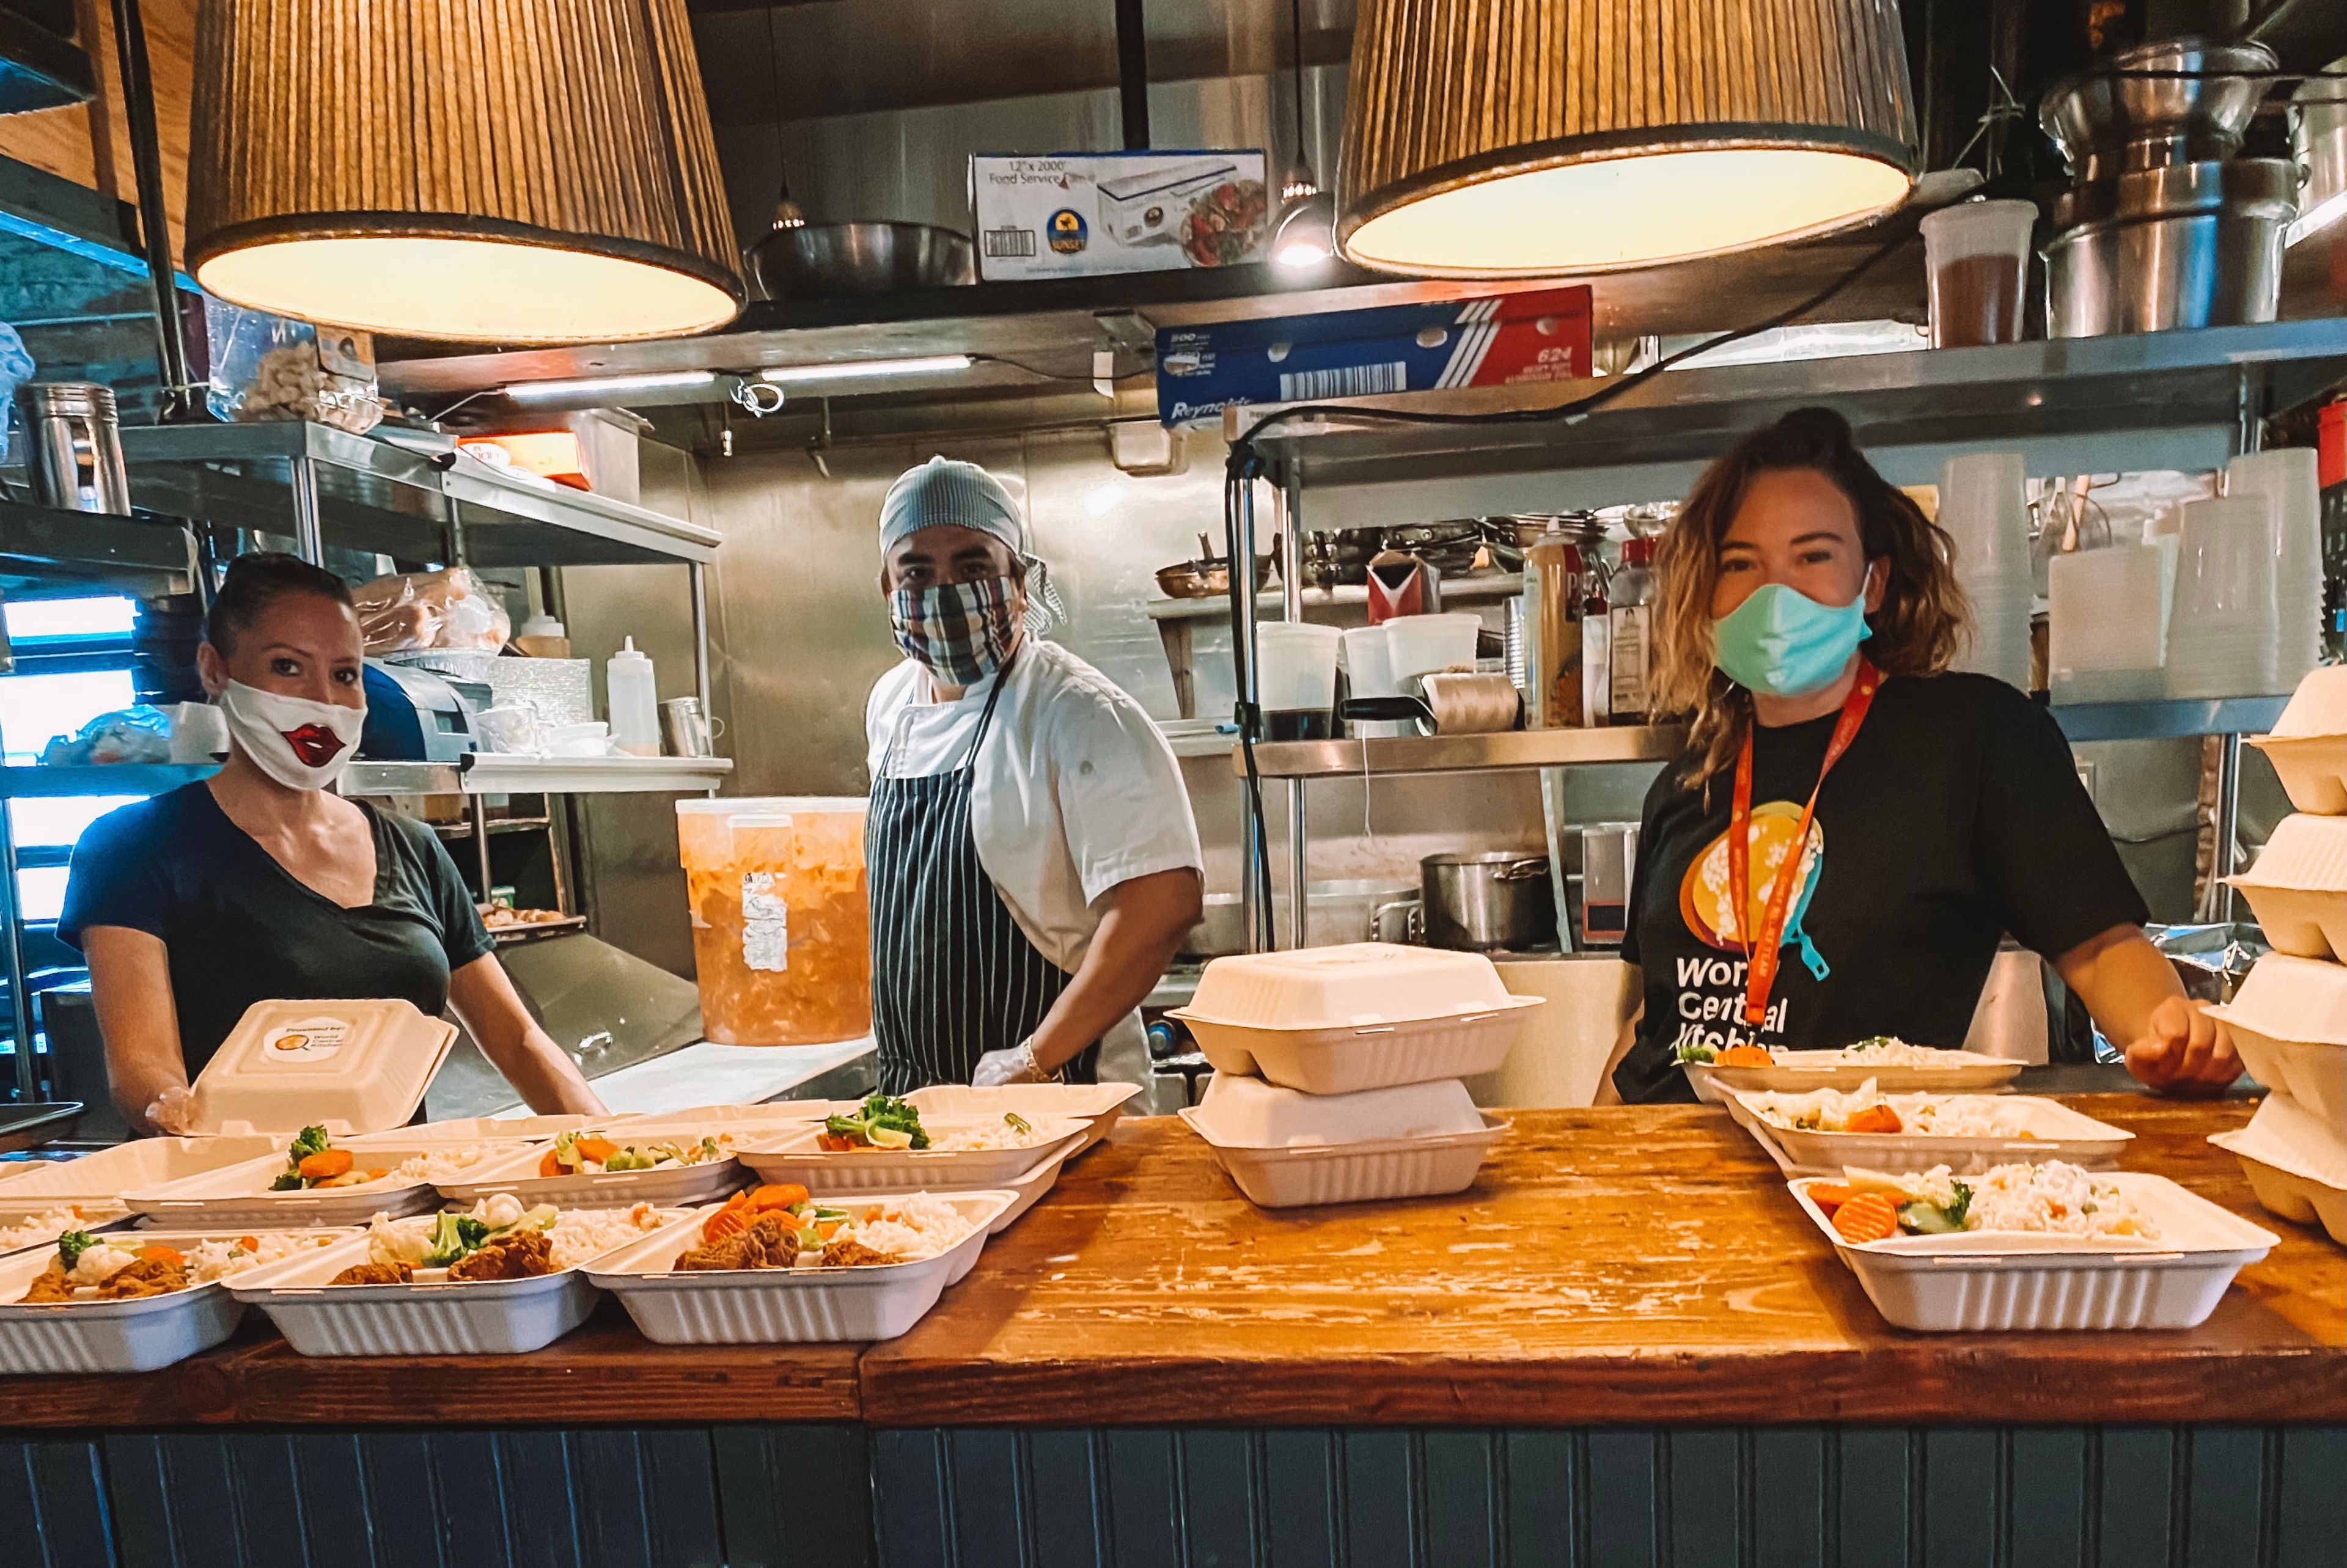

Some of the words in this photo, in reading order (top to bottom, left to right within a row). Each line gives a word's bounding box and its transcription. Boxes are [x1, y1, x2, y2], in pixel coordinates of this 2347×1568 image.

[1028, 163, 1035, 172] x
[989, 172, 1018, 184] Food
[1020, 172, 1060, 184] Service
[1537, 346, 1573, 363] 624
[1677, 957, 1779, 987] Wor
[1678, 991, 1788, 1034] Cental
